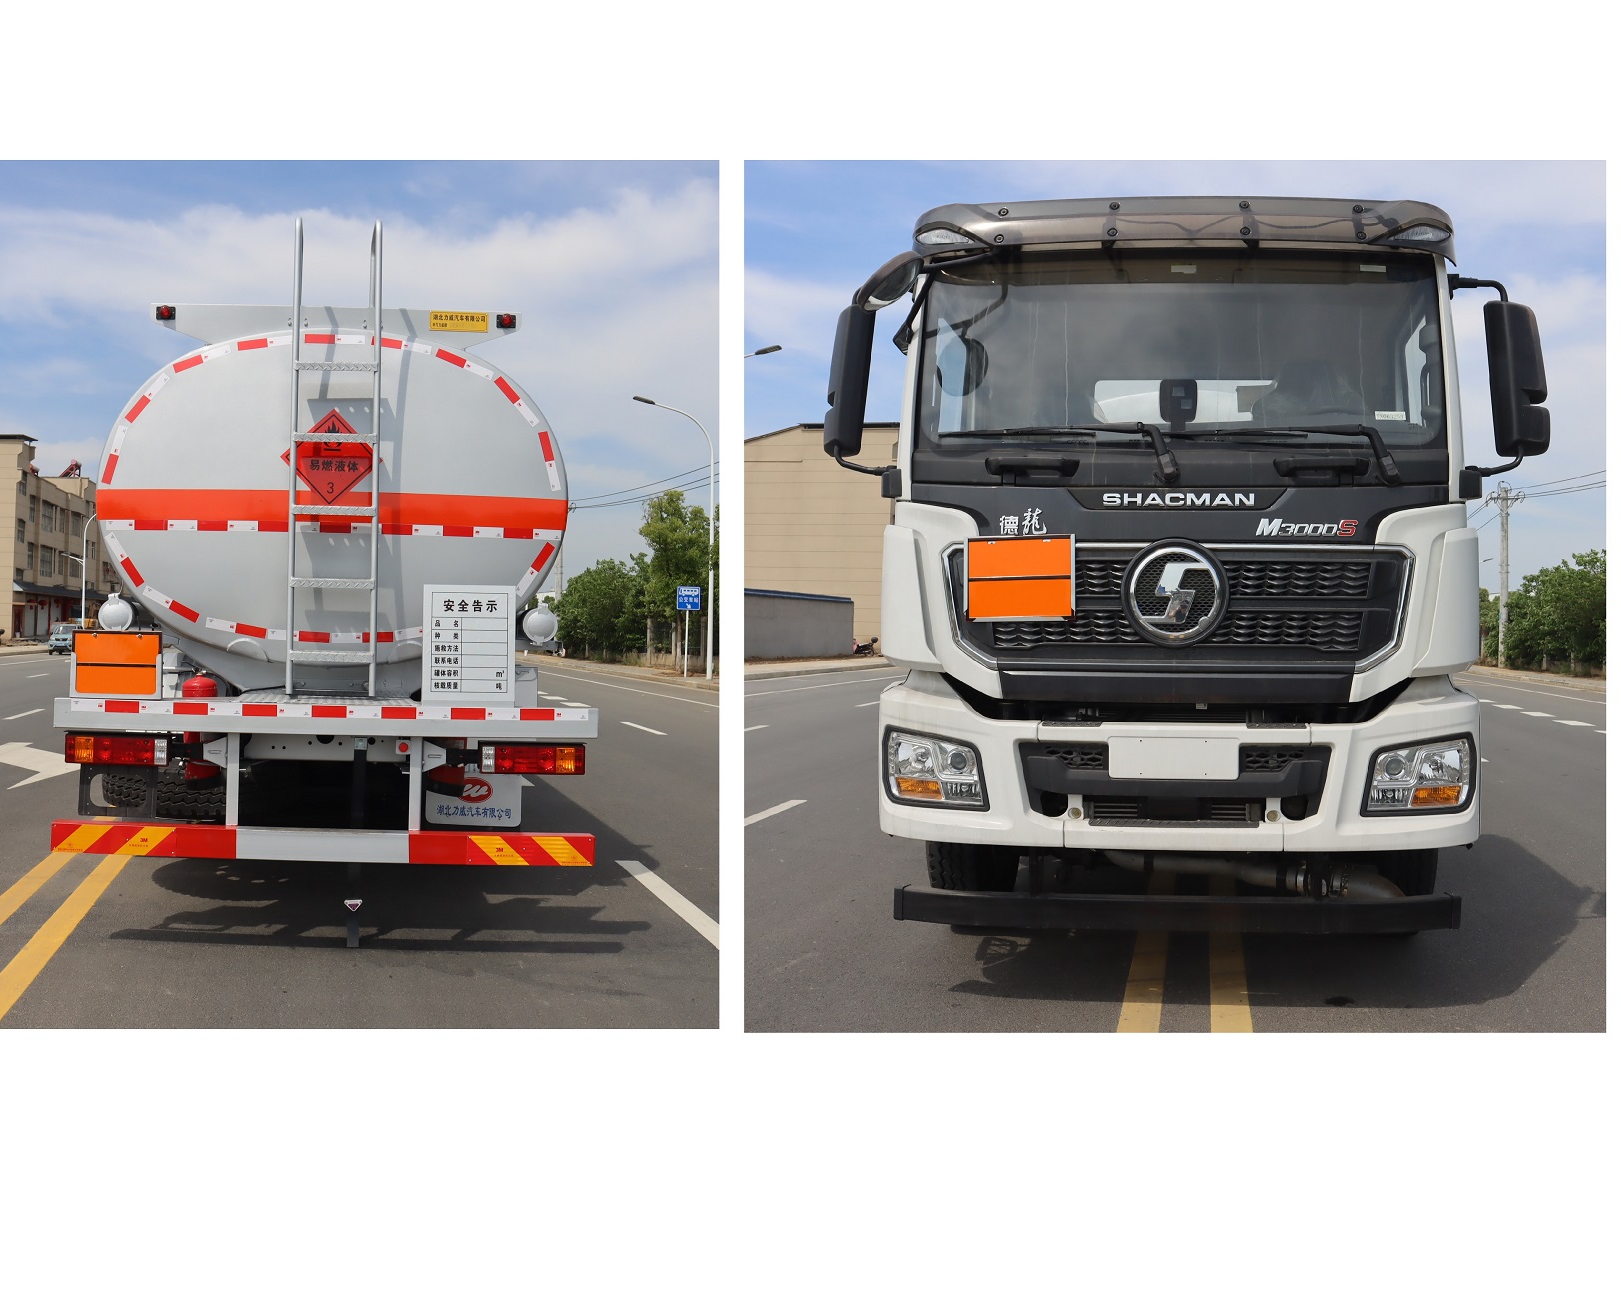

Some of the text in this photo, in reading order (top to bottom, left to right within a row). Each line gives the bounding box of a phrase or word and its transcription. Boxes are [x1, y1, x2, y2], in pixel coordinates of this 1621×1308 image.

[433, 314, 485, 322] 湖北力威汽车有限公司
[310, 459, 359, 472] 易燃液体
[326, 482, 335, 494] 3
[1102, 492, 1256, 508] SHACMAN
[1256, 518, 1359, 537] M3000S
[443, 599, 498, 613] 安全告示
[434, 669, 459, 677] 罐体容积
[437, 804, 512, 819] 湖北力威汽车有限公司
